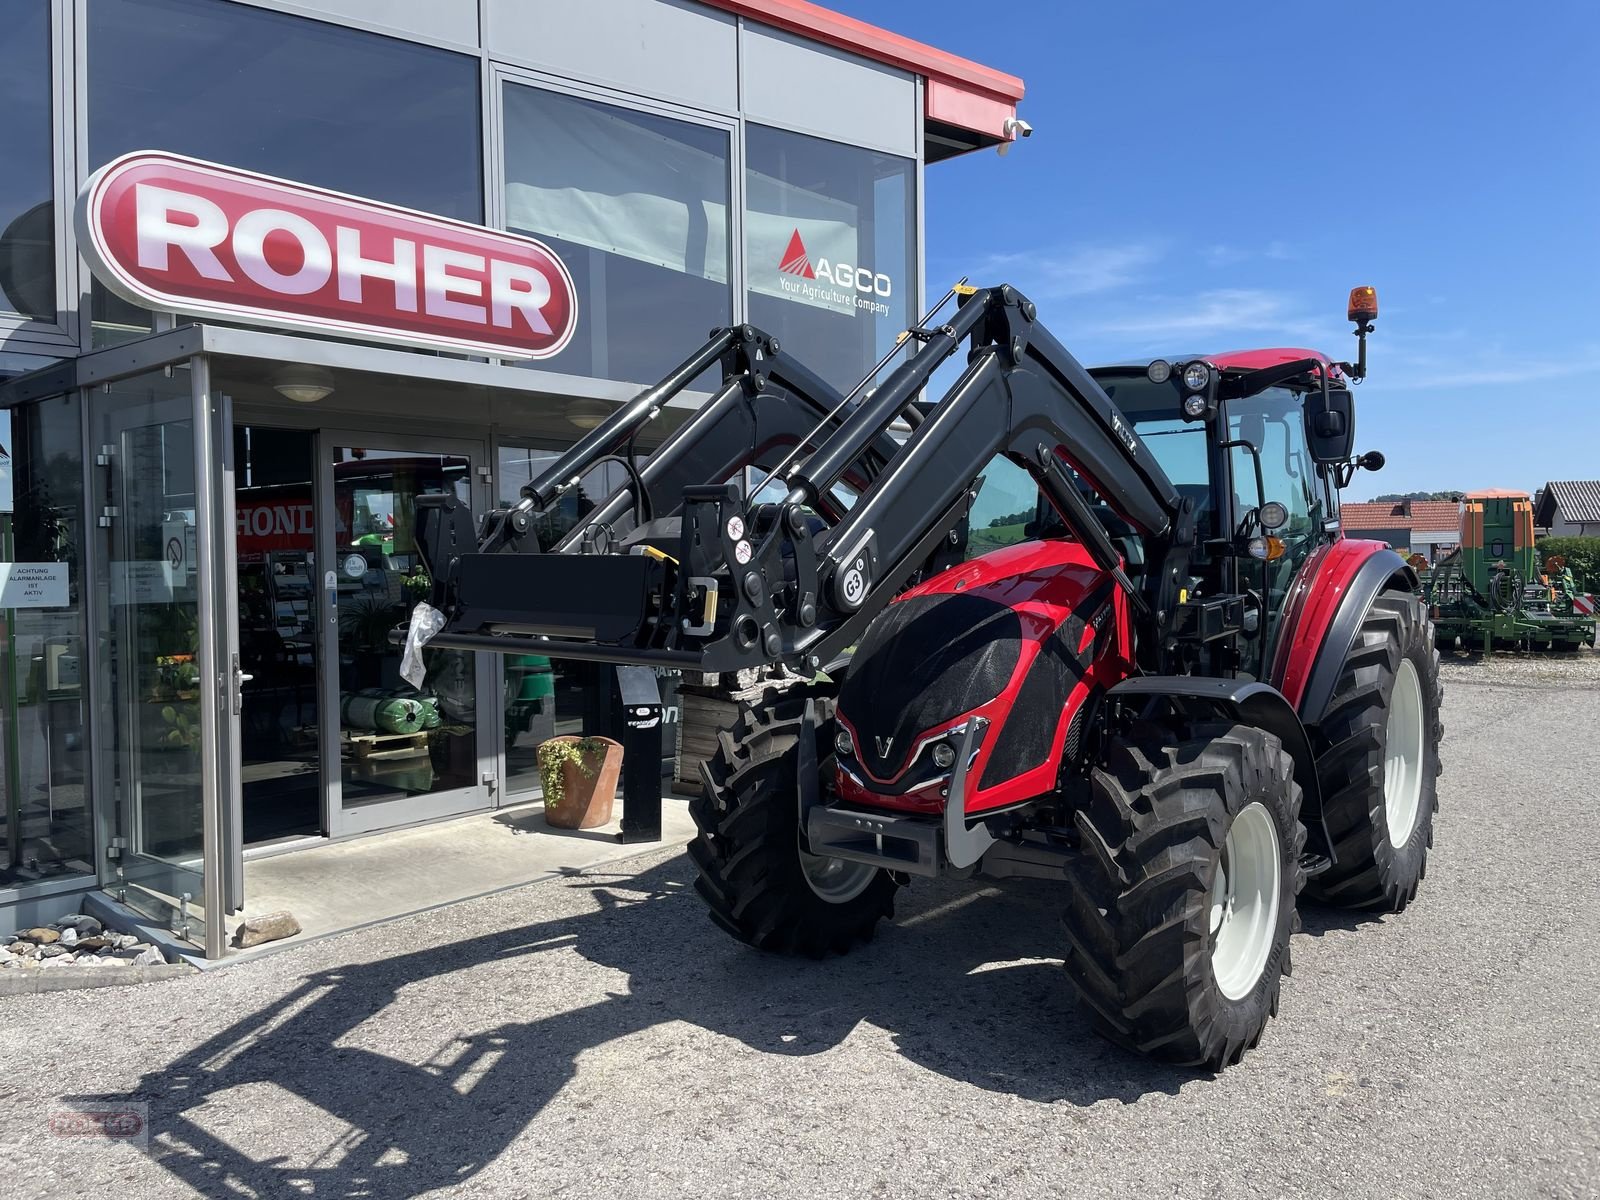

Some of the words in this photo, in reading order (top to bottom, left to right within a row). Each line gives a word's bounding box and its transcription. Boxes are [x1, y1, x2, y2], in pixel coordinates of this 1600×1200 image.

[135, 183, 554, 336] ROHER
[815, 258, 892, 297] AGCO
[779, 277, 801, 293] Your
[802, 283, 850, 306] Agriculture
[852, 294, 890, 317] Company
[846, 573, 861, 597] G3
